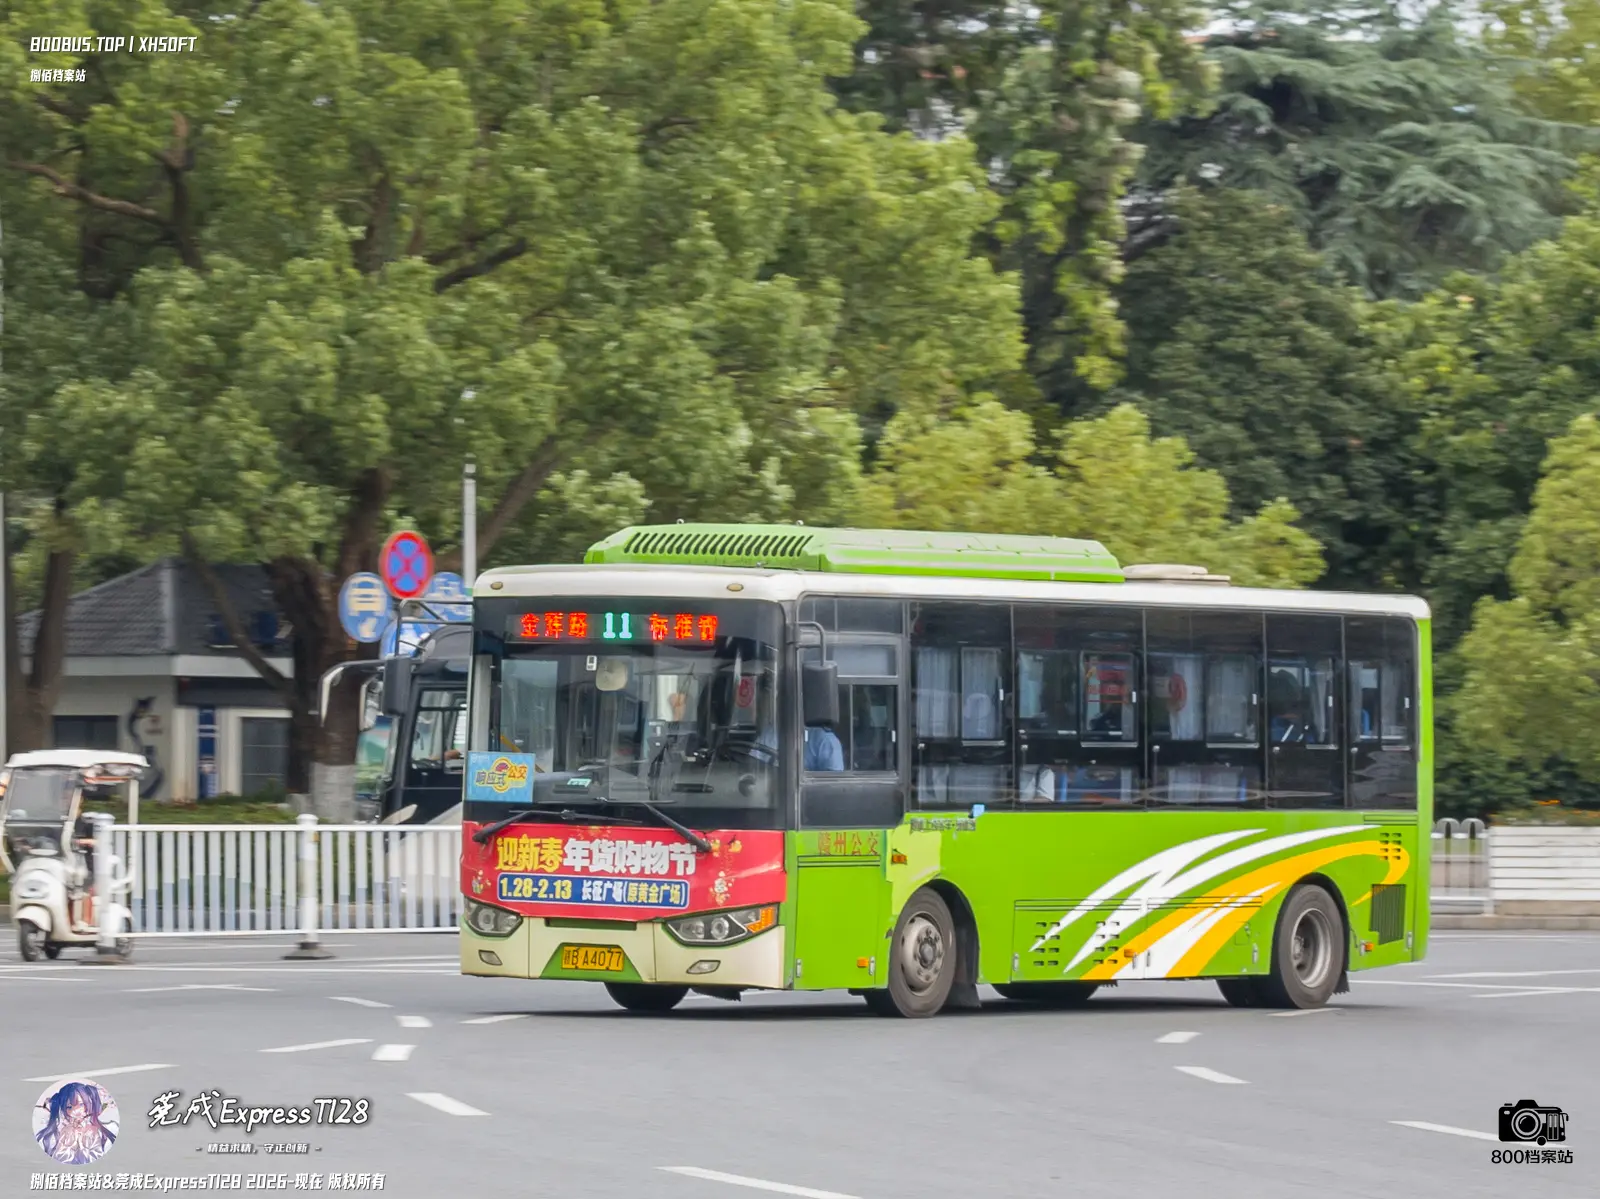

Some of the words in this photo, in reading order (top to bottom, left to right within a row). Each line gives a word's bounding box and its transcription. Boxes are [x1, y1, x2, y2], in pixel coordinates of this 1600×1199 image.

[602, 612, 633, 639] 11
[495, 834, 697, 876] 迎新春年货购物节
[817, 831, 880, 856] 赣州公交
[500, 878, 572, 900] 1.28-2.13
